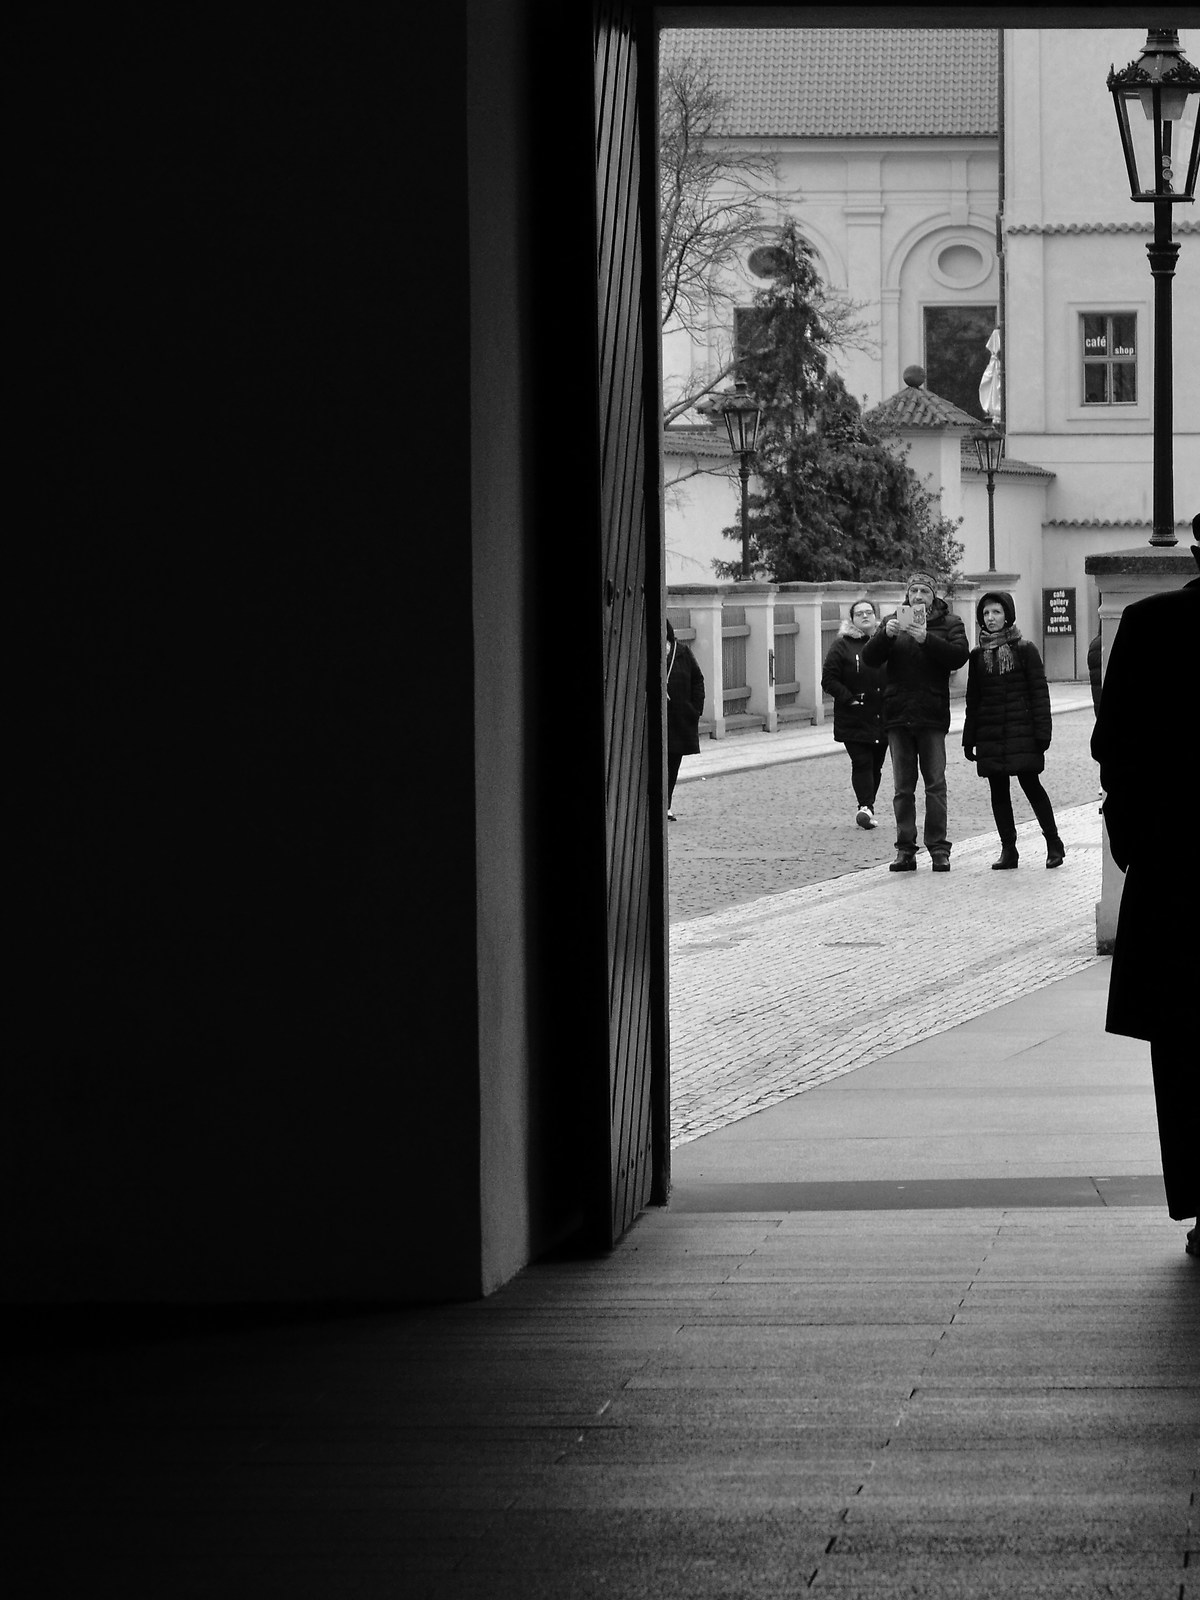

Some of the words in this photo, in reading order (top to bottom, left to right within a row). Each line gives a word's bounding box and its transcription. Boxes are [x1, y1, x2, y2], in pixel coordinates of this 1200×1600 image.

[1085, 336, 1106, 347] café
[1114, 346, 1134, 356] shop
[1053, 590, 1065, 598] café
[1052, 606, 1066, 614] shop
[1050, 615, 1069, 624] garden
